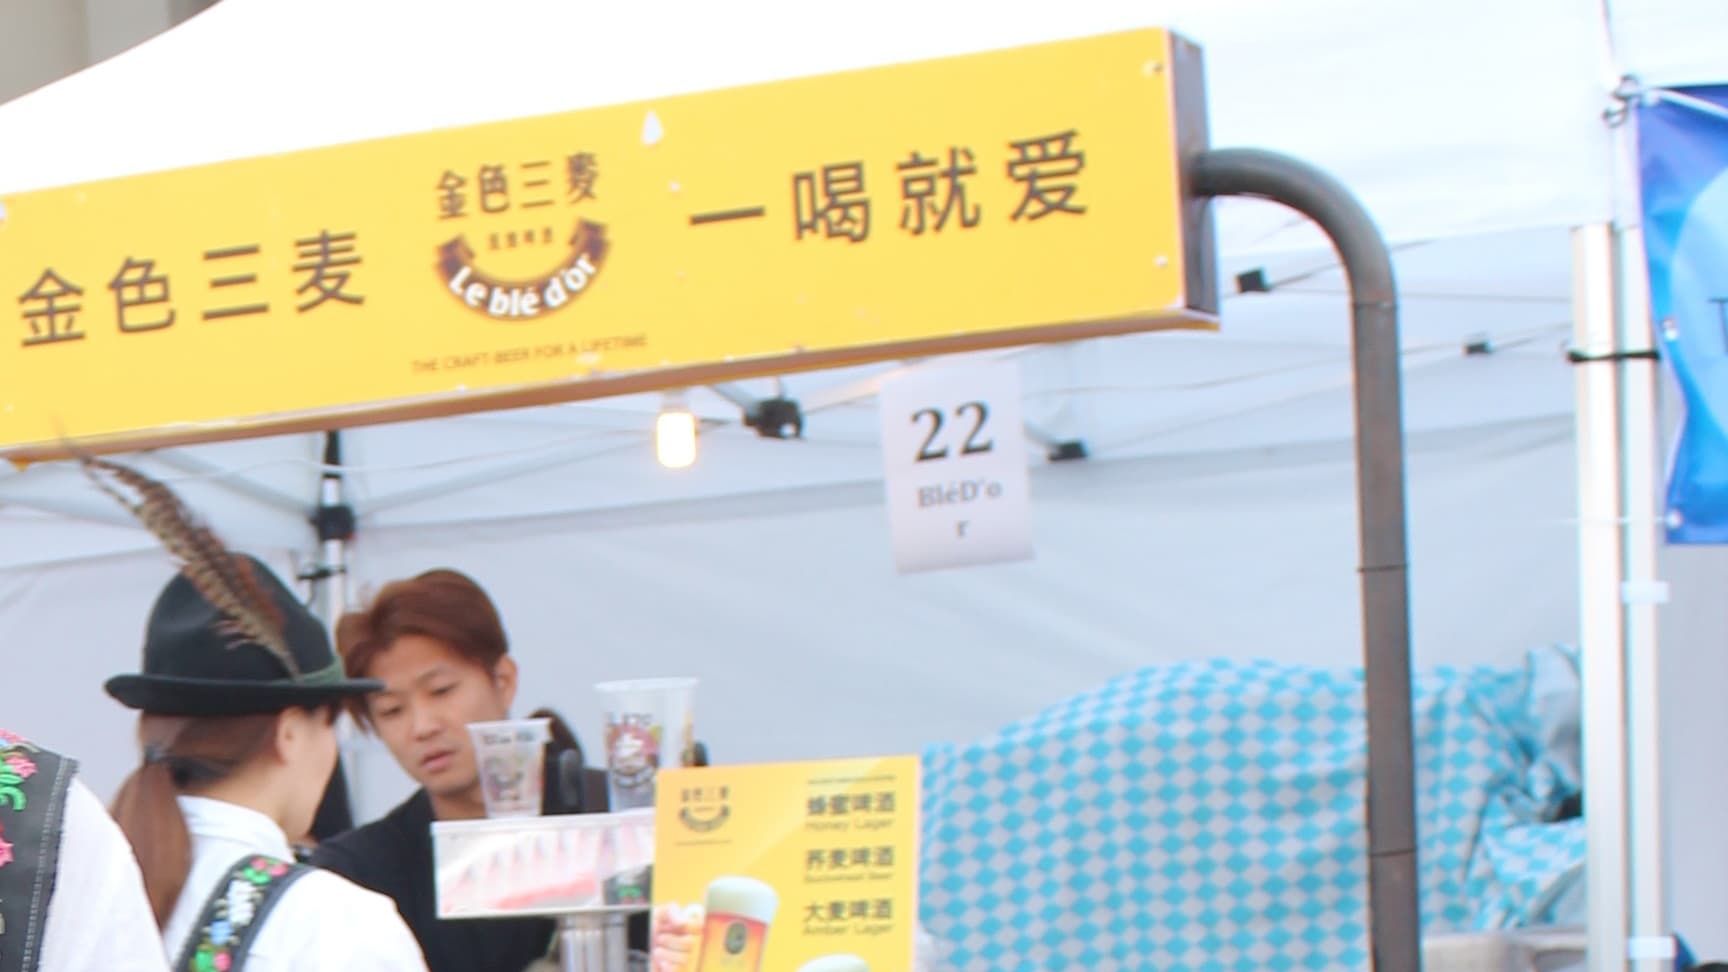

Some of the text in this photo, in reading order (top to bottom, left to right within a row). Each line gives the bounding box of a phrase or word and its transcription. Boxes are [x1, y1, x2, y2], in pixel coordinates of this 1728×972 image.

[689, 130, 1087, 244] 一喝就爱
[18, 229, 366, 348] 金色三麦
[448, 265, 489, 307] Le
[487, 285, 540, 317] blé
[910, 400, 994, 463] 22
